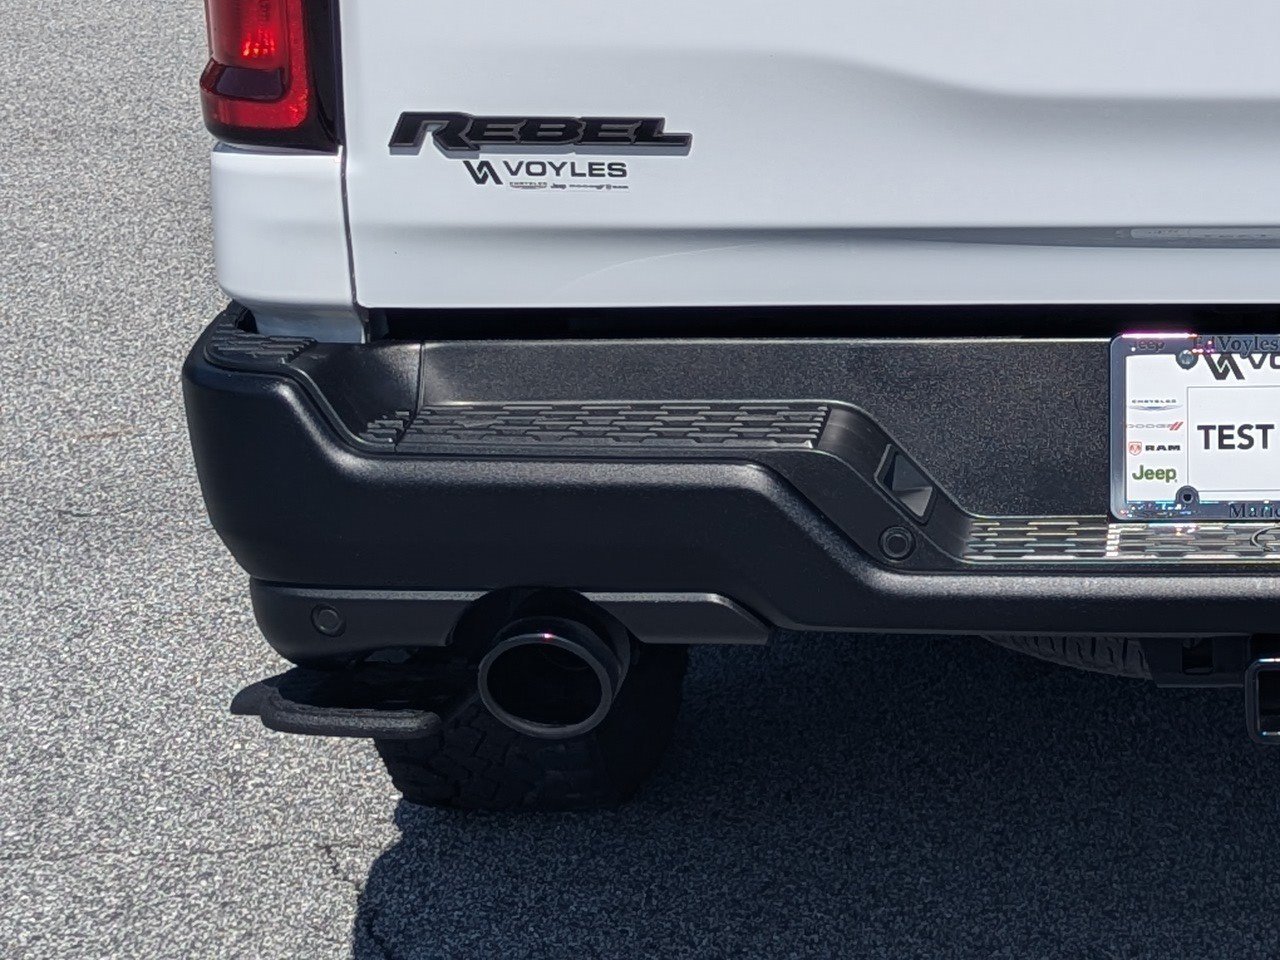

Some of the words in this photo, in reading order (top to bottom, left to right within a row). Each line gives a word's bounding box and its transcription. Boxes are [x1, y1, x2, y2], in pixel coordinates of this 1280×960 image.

[389, 111, 692, 158] REBEL
[503, 161, 627, 178] VOYLES
[1197, 424, 1274, 450] TEST
[1132, 465, 1177, 483] Jeep
